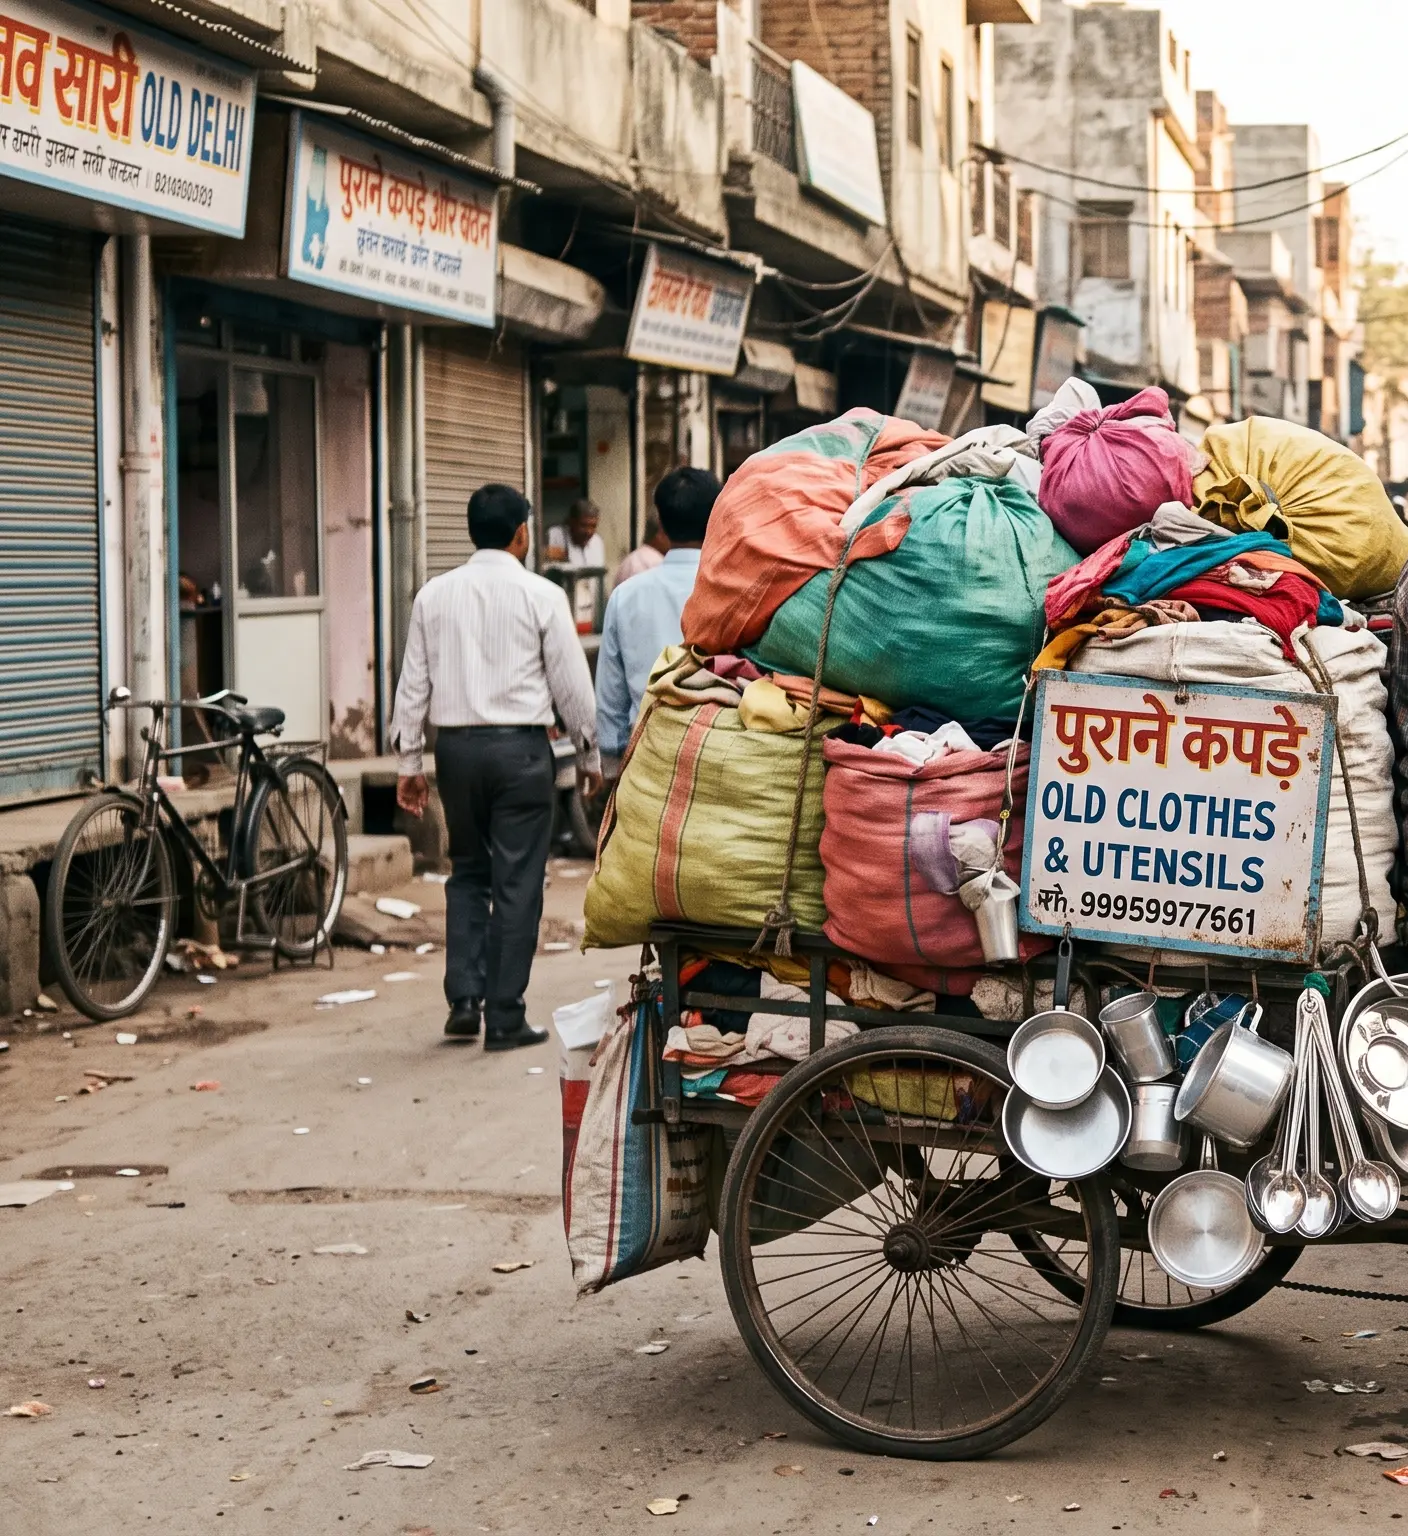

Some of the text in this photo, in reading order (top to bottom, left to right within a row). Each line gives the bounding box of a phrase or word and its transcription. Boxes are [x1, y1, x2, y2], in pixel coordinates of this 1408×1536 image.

[53, 31, 139, 143] सारी
[141, 71, 245, 173] OLD DELHI
[339, 153, 384, 221] पुराने
[387, 170, 428, 236] कपड़े
[1050, 693, 1308, 792] पुराने कपड़े
[1041, 780, 1277, 842] OLD CLOTHES
[1043, 836, 1265, 893] & UTENSILS
